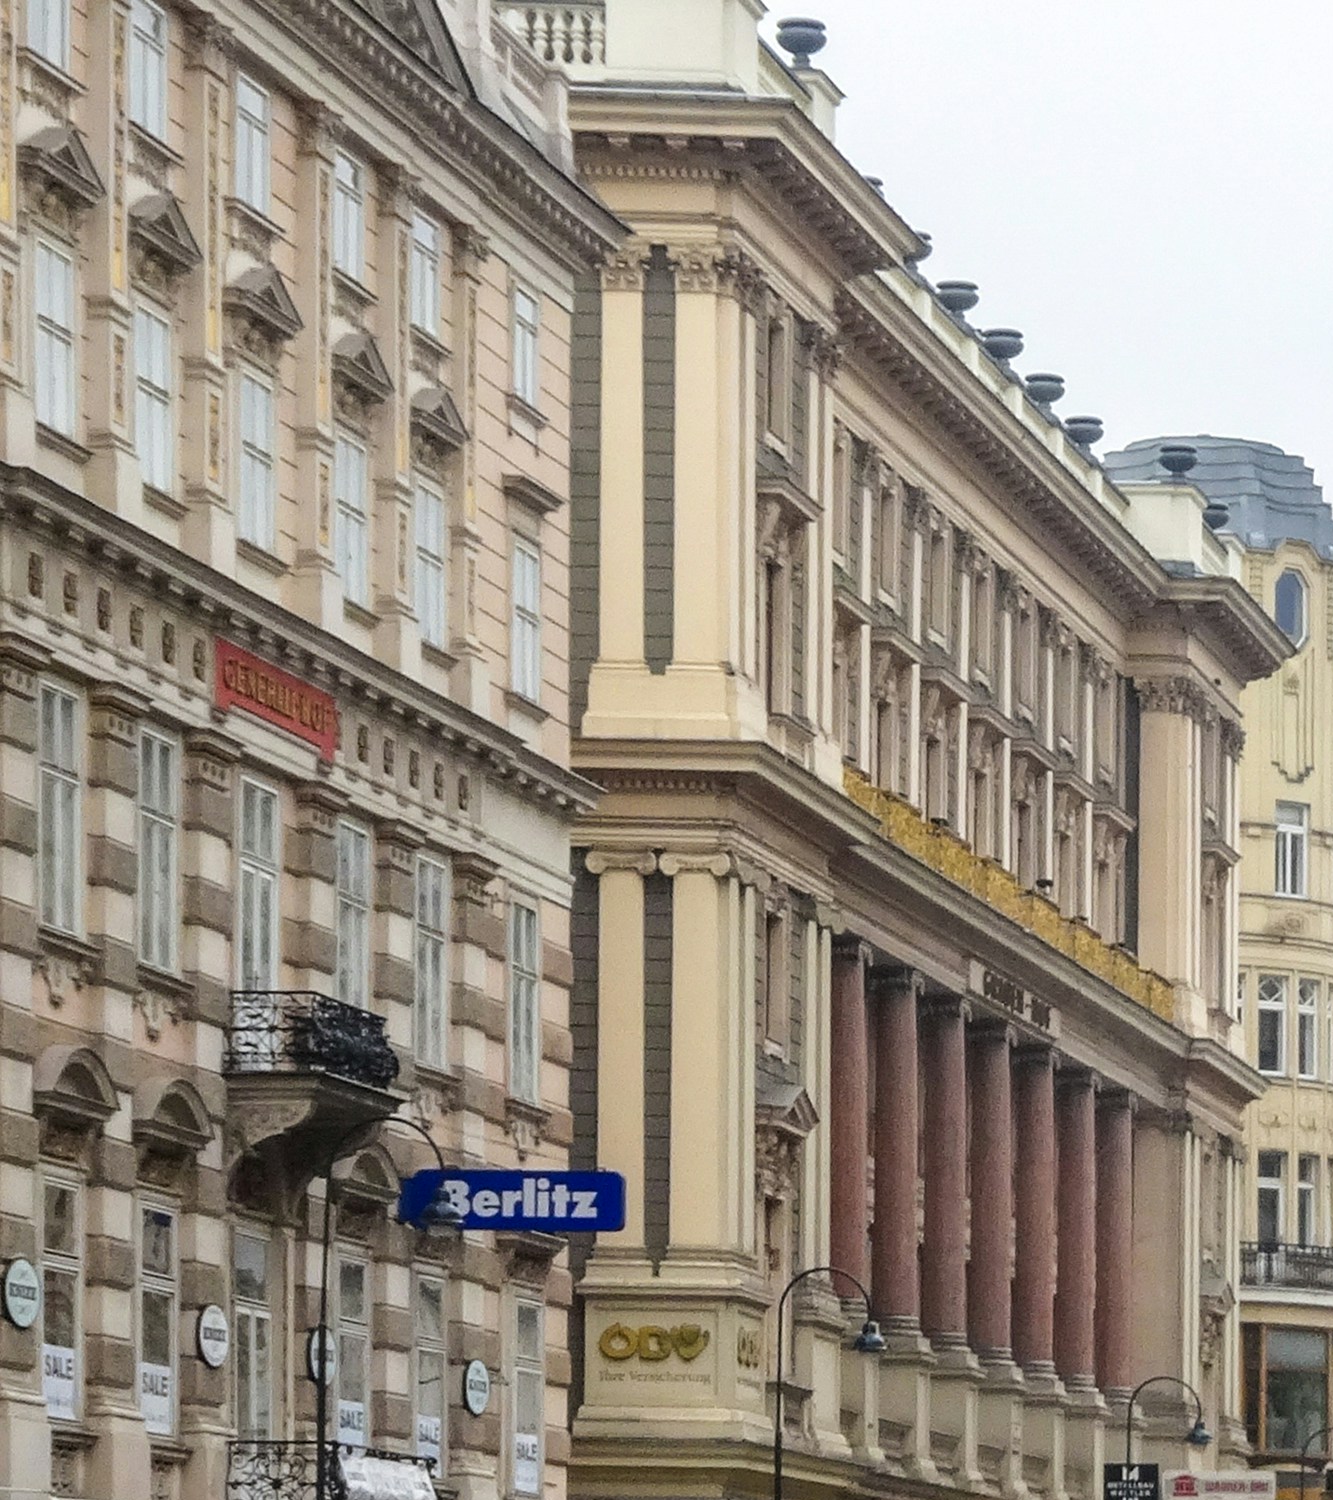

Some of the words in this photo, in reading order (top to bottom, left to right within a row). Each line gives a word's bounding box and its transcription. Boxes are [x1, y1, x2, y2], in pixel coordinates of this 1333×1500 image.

[442, 1178, 598, 1219] Berlitz
[44, 1353, 74, 1381] SALE
[142, 1371, 168, 1398] SALE
[339, 1408, 364, 1432] SALE
[419, 1423, 440, 1446] SALE
[516, 1441, 538, 1463] SALE
